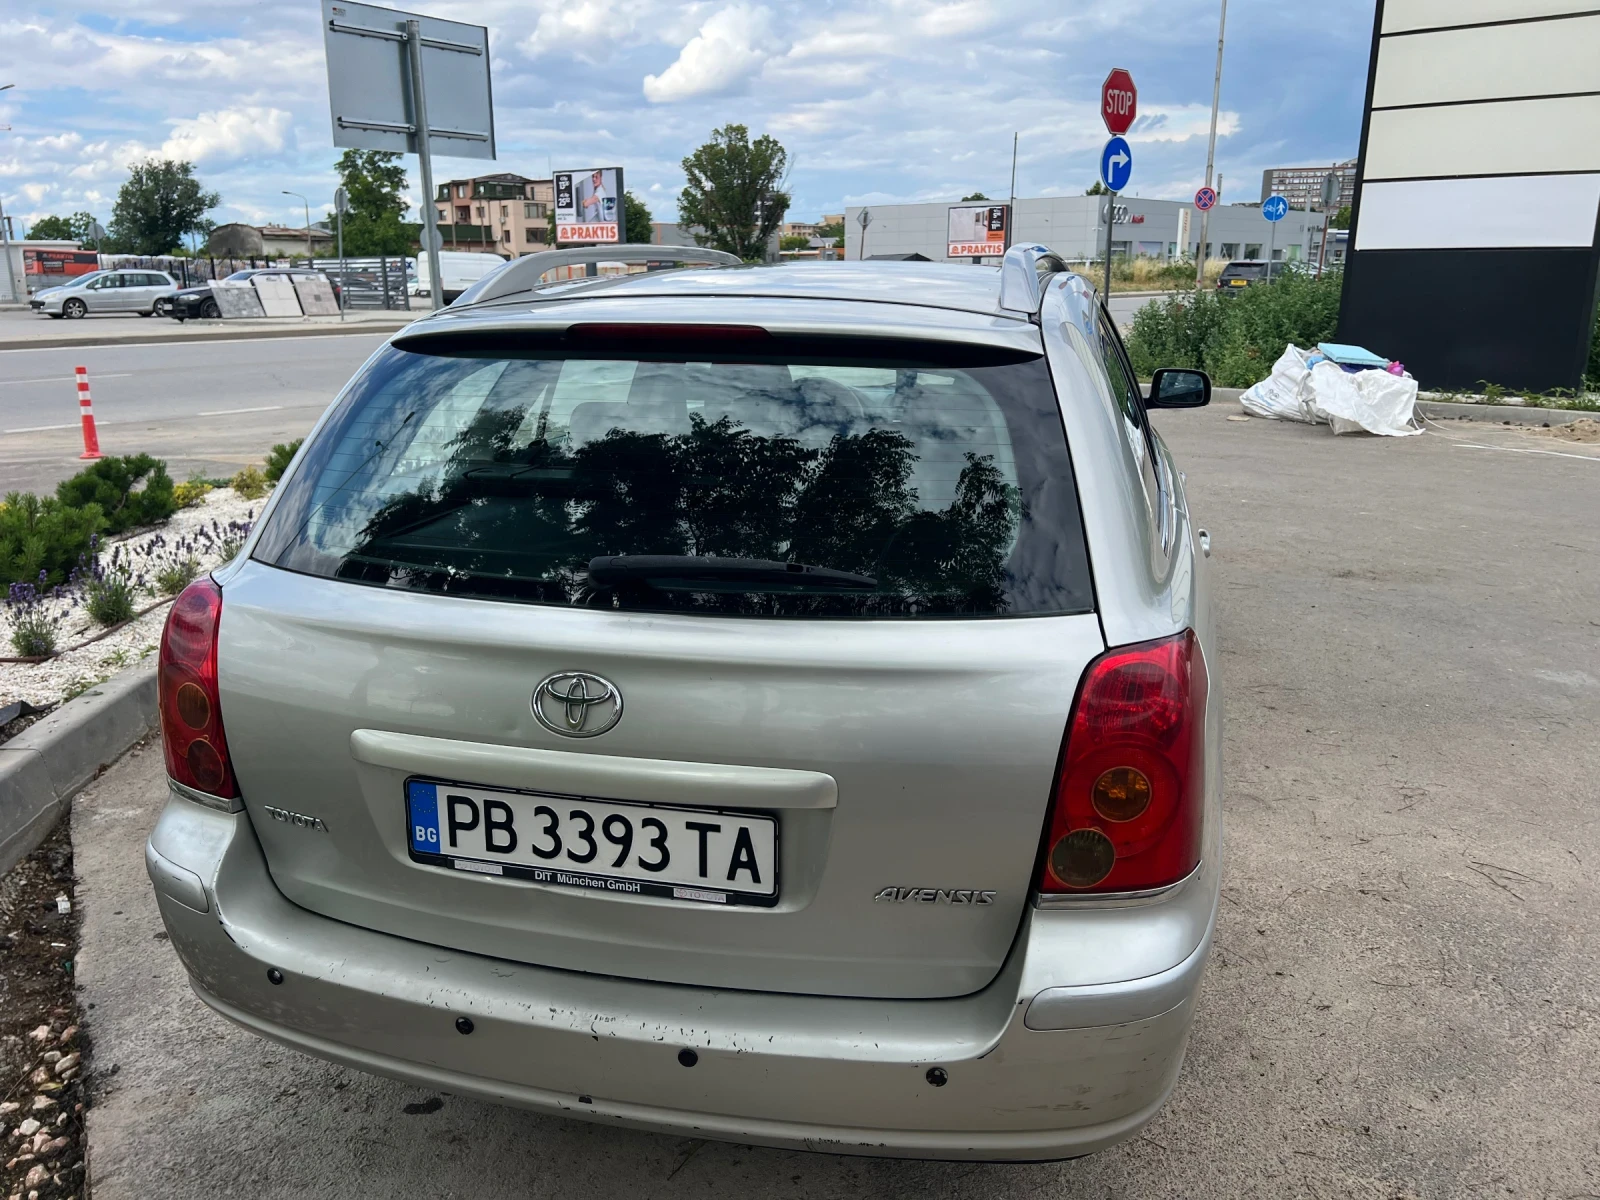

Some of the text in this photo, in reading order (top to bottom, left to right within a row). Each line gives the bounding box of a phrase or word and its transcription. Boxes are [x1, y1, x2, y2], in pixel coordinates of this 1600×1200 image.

[1106, 88, 1133, 116] STOP
[570, 226, 616, 239] PRAKTIS
[960, 244, 1002, 254] PRAKTIS
[264, 805, 329, 832] TOYOTA
[415, 825, 437, 843] BG
[446, 794, 762, 884] PB 3393 TA
[534, 870, 641, 893] DIT München GmbH
[688, 891, 725, 903] TOYOTA
[874, 886, 997, 906] AVENSIS
